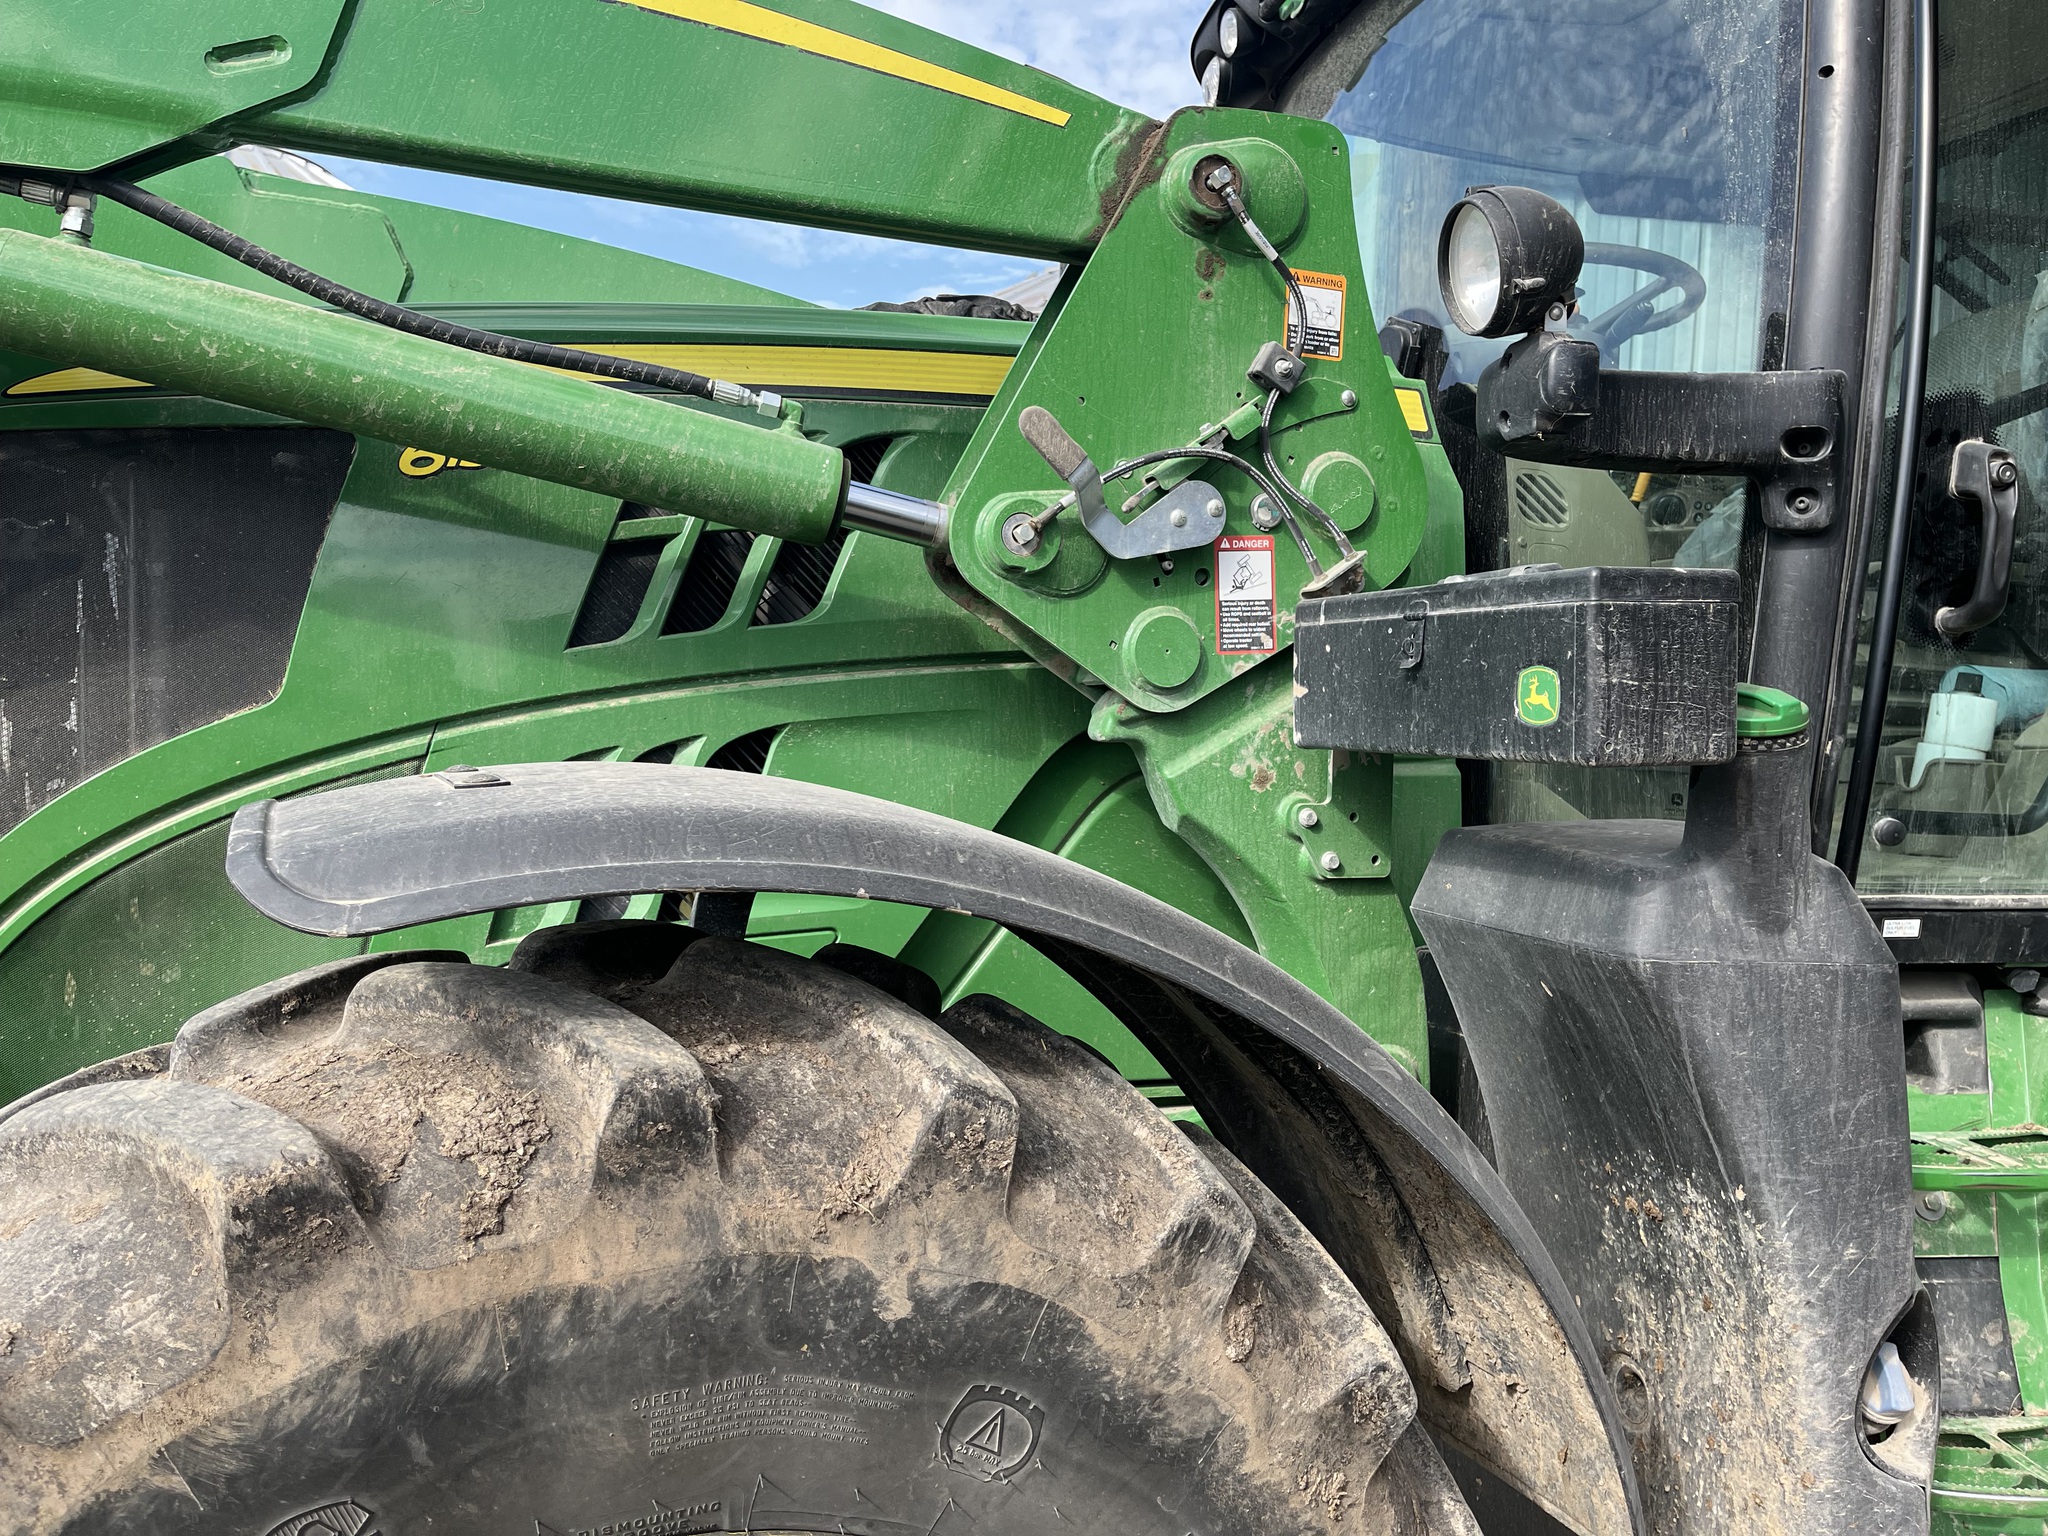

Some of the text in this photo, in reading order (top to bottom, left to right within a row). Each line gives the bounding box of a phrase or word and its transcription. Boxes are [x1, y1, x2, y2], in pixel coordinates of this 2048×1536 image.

[1303, 275, 1342, 288] WARNING
[1233, 540, 1270, 548] DANGER
[630, 1373, 769, 1411] SAFETY WARNING:
[784, 1375, 814, 1385] SERIOUS
[817, 1379, 843, 1389] INJURY
[846, 1382, 861, 1392] MAY
[865, 1386, 892, 1396] RESULT
[650, 1402, 693, 1418] EXPLOSION
[697, 1400, 708, 1408] OF
[749, 1388, 786, 1397] ASSEMBLY
[790, 1389, 804, 1397] DUE
[808, 1390, 818, 1398] TO
[821, 1392, 855, 1404] IMPROPER
[650, 1418, 676, 1429] NEVER
[680, 1410, 709, 1422] EXCEED
[726, 1403, 740, 1411] PSI
[758, 1398, 777, 1407] SEAT
[649, 1435, 681, 1448] FOLLOW
[684, 1423, 740, 1440] INSTRUCTIONS
[755, 1417, 794, 1426] EQUIPMENT
[797, 1420, 827, 1430] OWNER'S
[650, 1427, 675, 1438] NEVER
[679, 1422, 700, 1432] WELD
[703, 1418, 715, 1427] ON
[718, 1414, 732, 1423] RIM
[735, 1409, 766, 1420] WITHOUT
[795, 1410, 830, 1421] REMOVING
[650, 1428, 870, 1457] ONLY SPECIALLY TRAINED PERSONS SHOULD MOUNT TIRES
[982, 1454, 1002, 1467] MAX
[577, 1501, 721, 1536] DISMOUNTING
